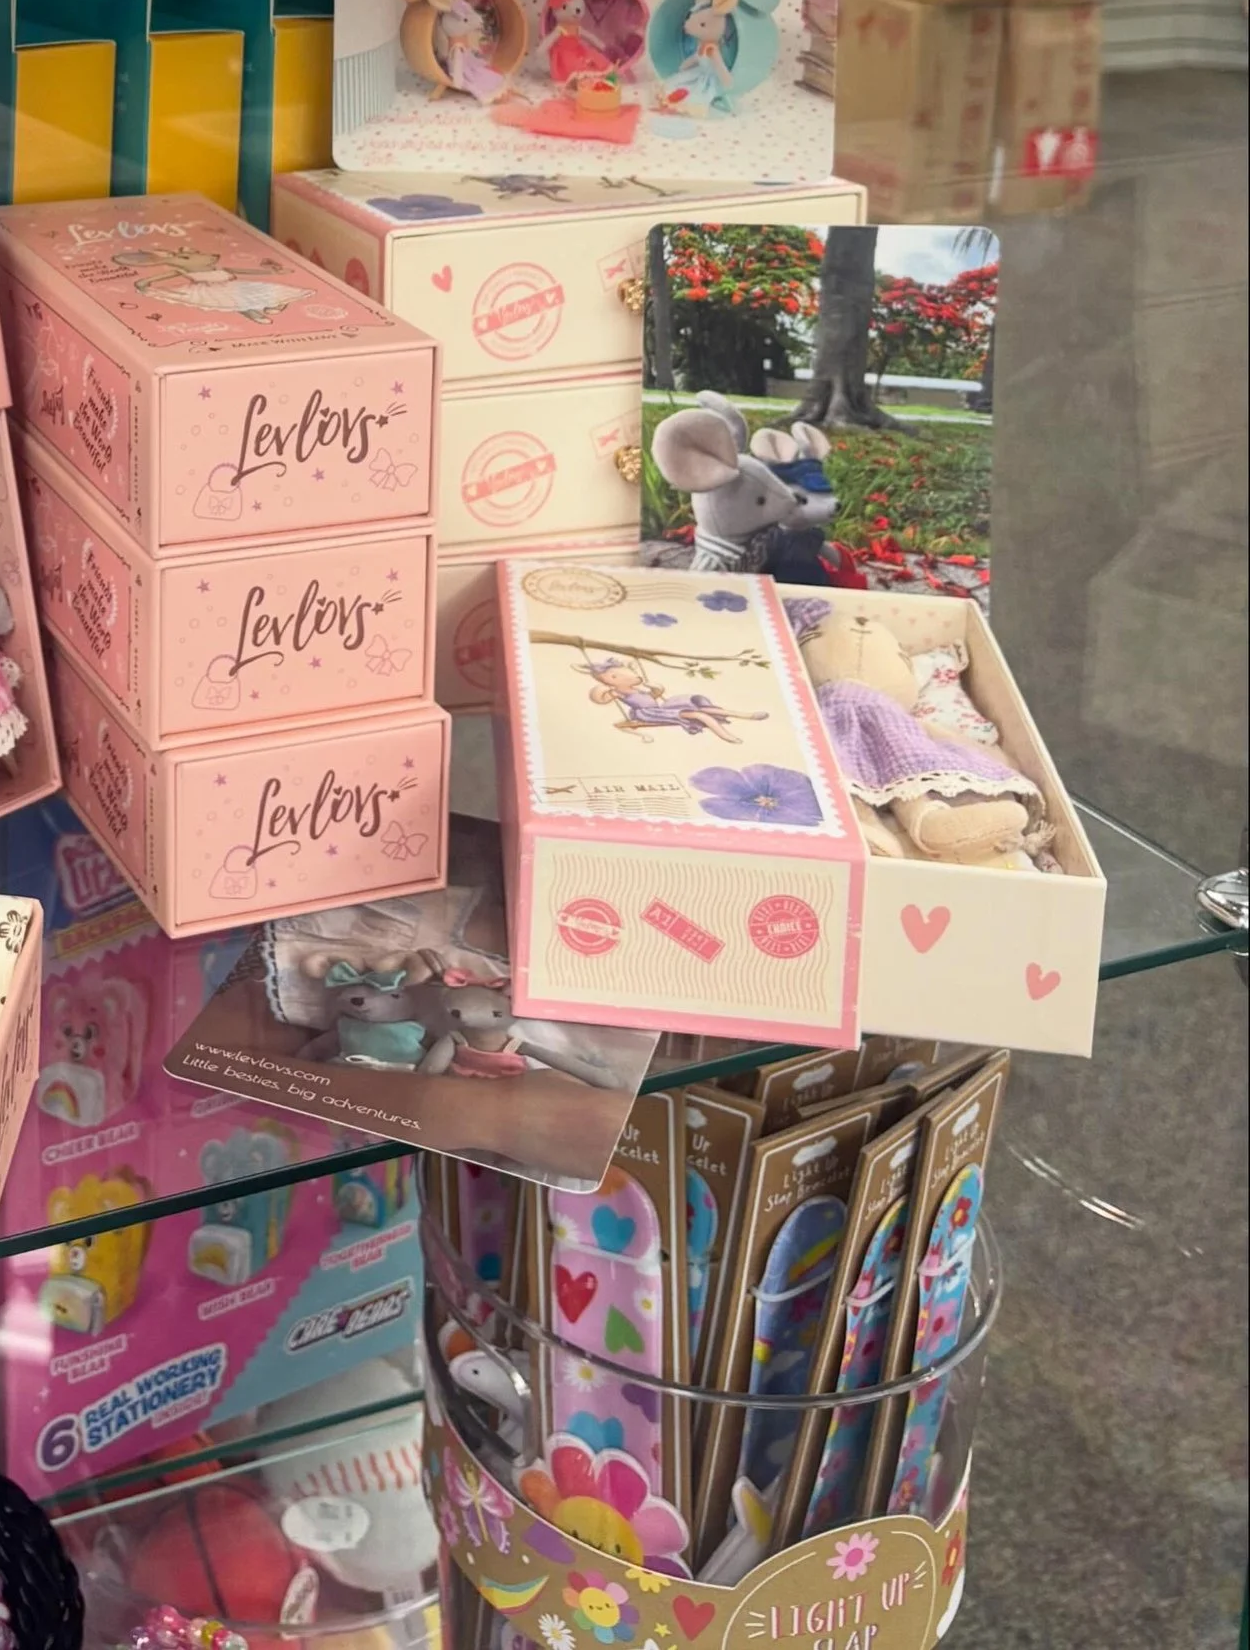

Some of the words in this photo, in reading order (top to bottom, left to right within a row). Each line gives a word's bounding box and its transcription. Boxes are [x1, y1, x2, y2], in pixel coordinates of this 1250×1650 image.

[230, 389, 379, 486] Levlovs
[228, 579, 374, 677] Levlovs
[245, 768, 388, 867] Levlovs
[590, 783, 624, 794] AIR
[635, 782, 681, 794] MAIL
[182, 1053, 219, 1073] Little
[287, 1083, 317, 1102] big
[194, 1040, 331, 1088] www.levlovs.com
[84, 1388, 132, 1428] REAL
[135, 1349, 221, 1394] WORKING
[87, 1367, 221, 1450] STATIONERY
[39, 1414, 78, 1471] 6
[770, 1591, 866, 1640] LIGHT
[881, 1572, 911, 1611] UP
